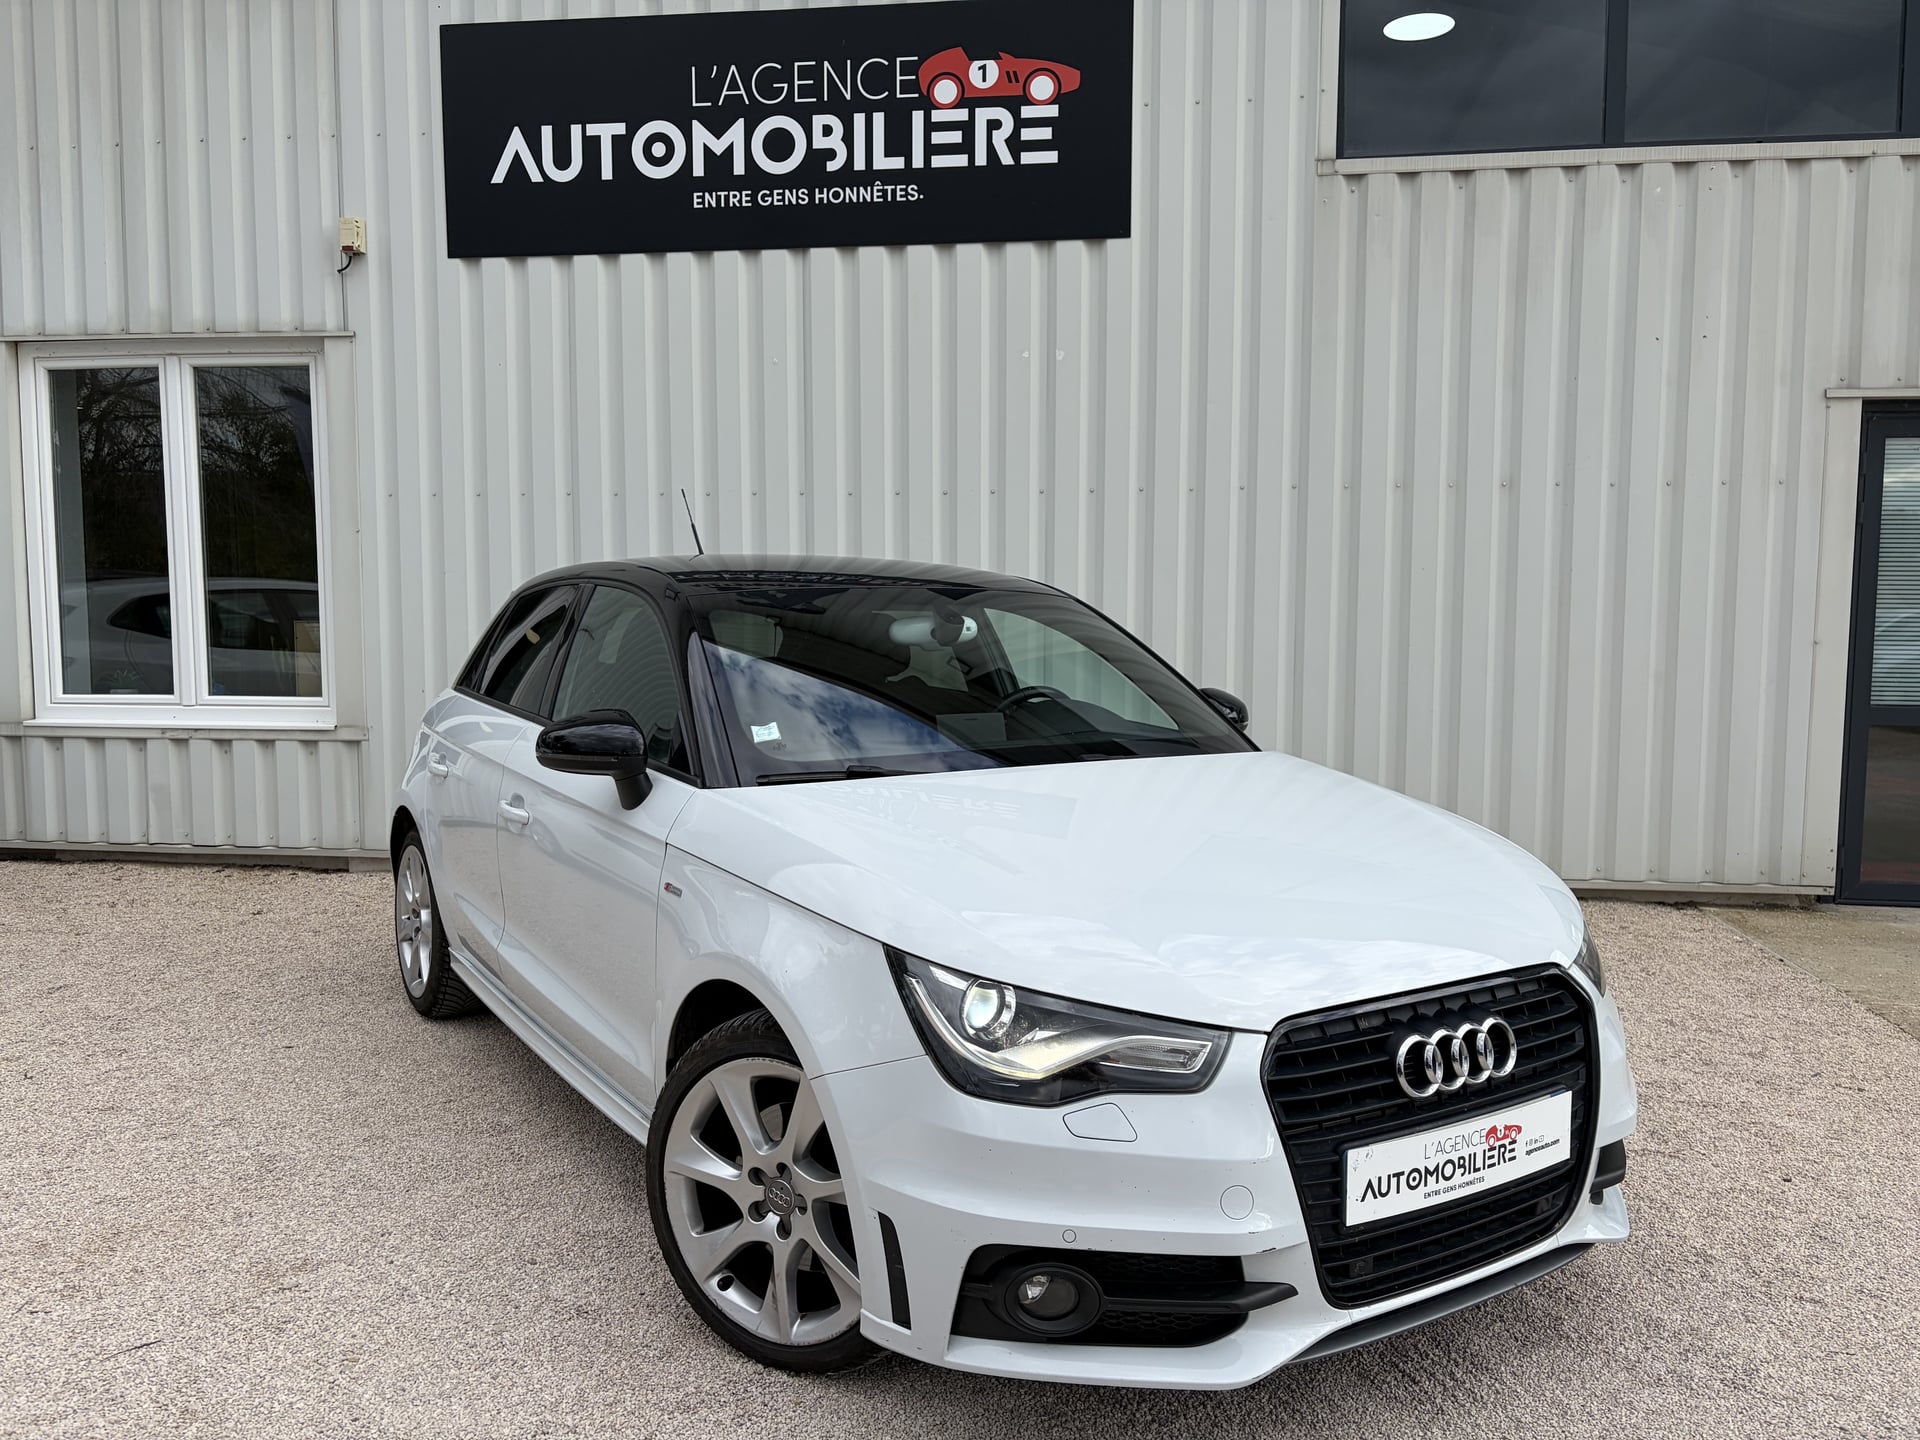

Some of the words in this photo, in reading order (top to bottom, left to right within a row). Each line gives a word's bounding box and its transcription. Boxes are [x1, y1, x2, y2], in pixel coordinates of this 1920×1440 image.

[691, 56, 919, 107] L'AGENCE
[977, 63, 988, 83] 1
[693, 190, 752, 209] ENTRE
[757, 188, 809, 207] GENS
[815, 181, 924, 205] HONNÊTES.
[1424, 1128, 1486, 1160] L'AGENCE
[1423, 1189, 1441, 1200] ENTRE
[1442, 1184, 1458, 1194] GENS
[1457, 1176, 1485, 1190] HONNÊTES
